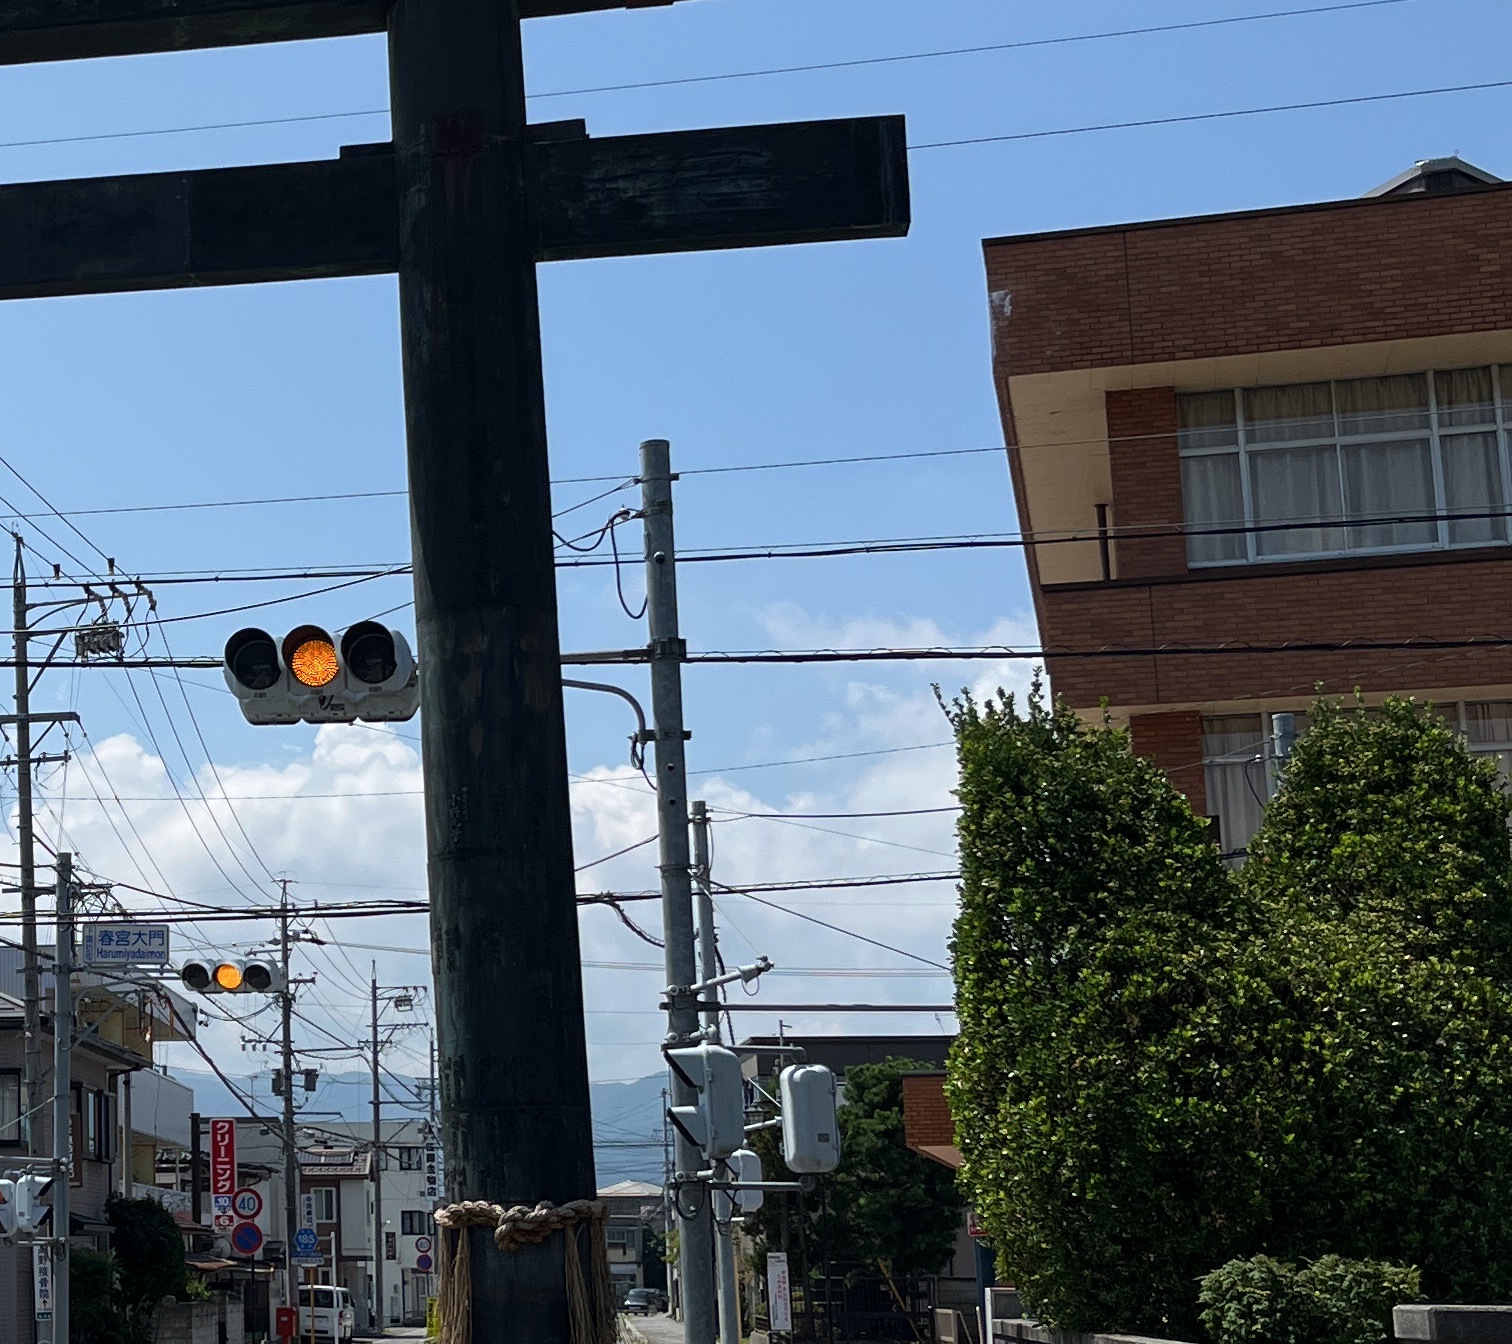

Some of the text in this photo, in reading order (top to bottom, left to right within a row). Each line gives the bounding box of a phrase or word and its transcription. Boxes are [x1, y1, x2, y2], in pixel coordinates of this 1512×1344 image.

[98, 929, 165, 947] 春宮大門
[96, 947, 166, 961] Harumiyadaimon
[216, 1121, 231, 1193] クリーニング
[216, 1197, 230, 1206] 10
[239, 1197, 256, 1211] 40
[219, 1215, 230, 1226] 6
[297, 1234, 316, 1244] 185
